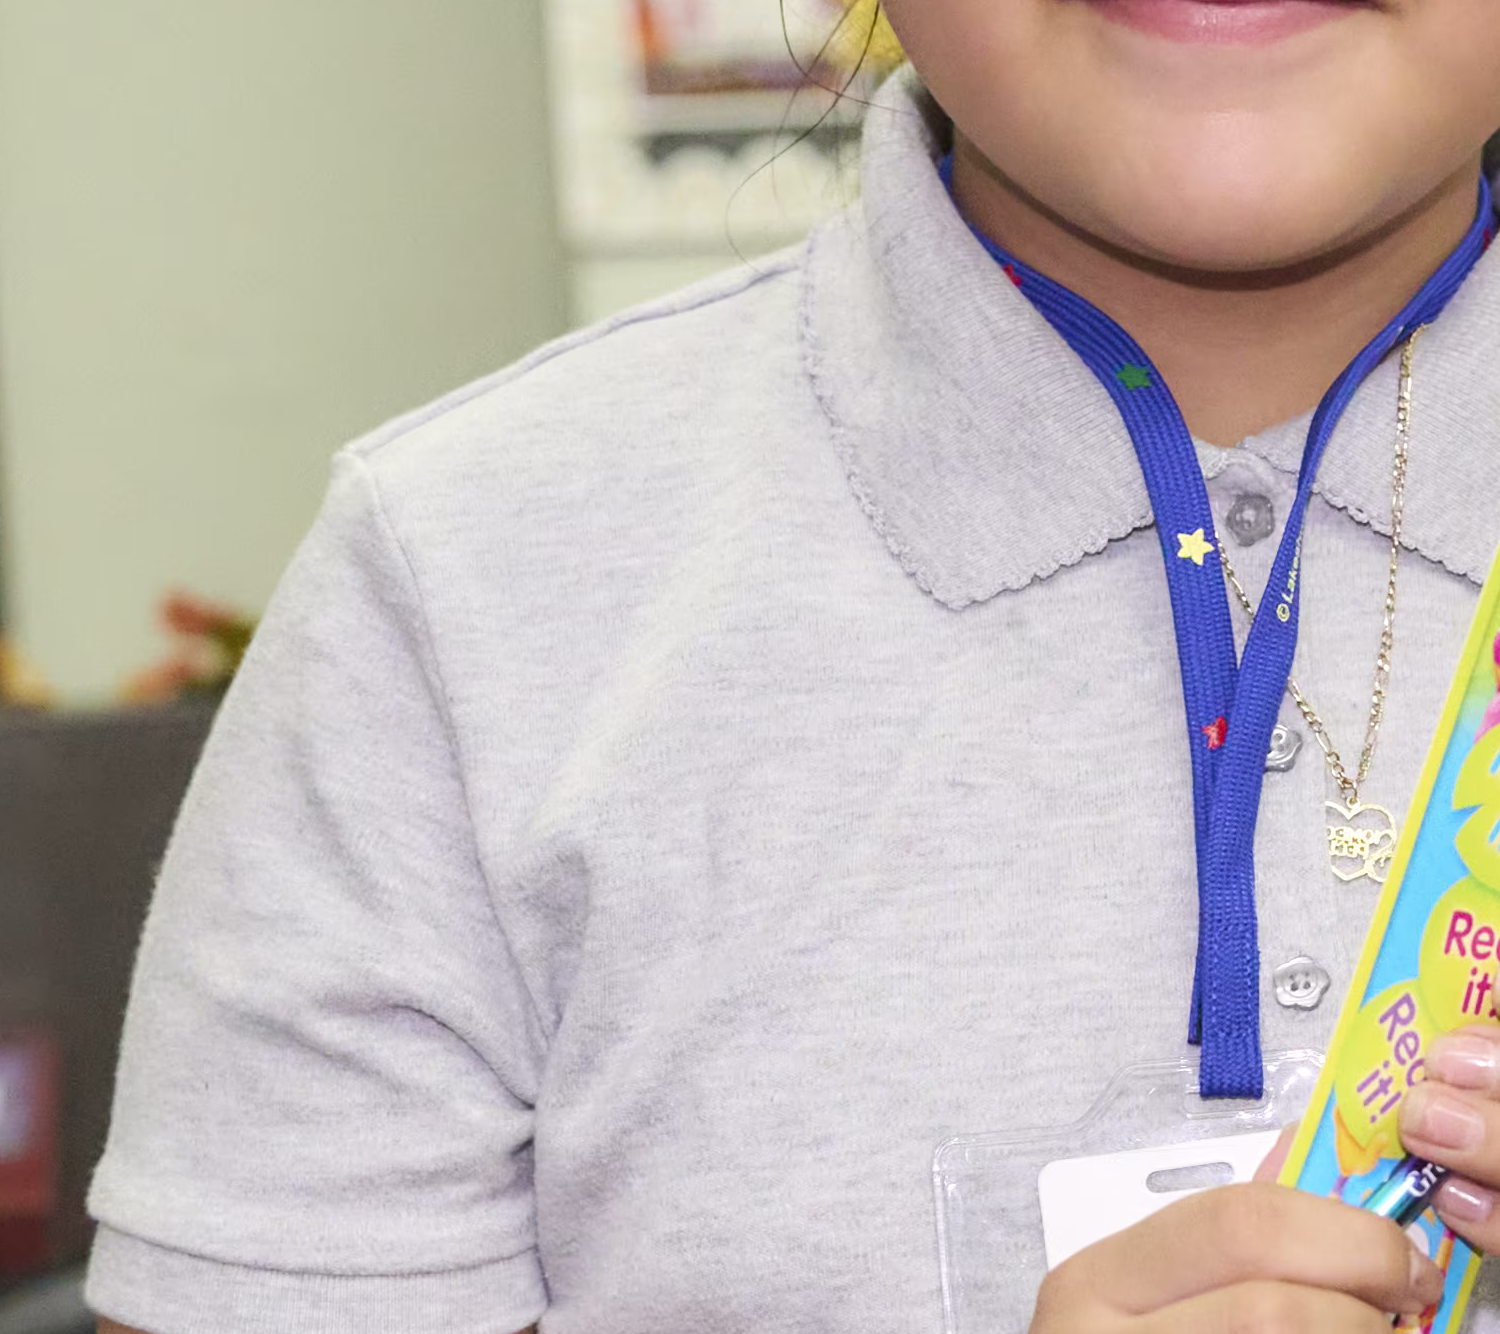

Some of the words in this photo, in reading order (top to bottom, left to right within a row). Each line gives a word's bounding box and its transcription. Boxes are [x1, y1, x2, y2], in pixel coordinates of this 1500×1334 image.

[1461, 967, 1497, 1018] it
[1379, 992, 1428, 1088] Rea
[1356, 1059, 1402, 1124] it!
